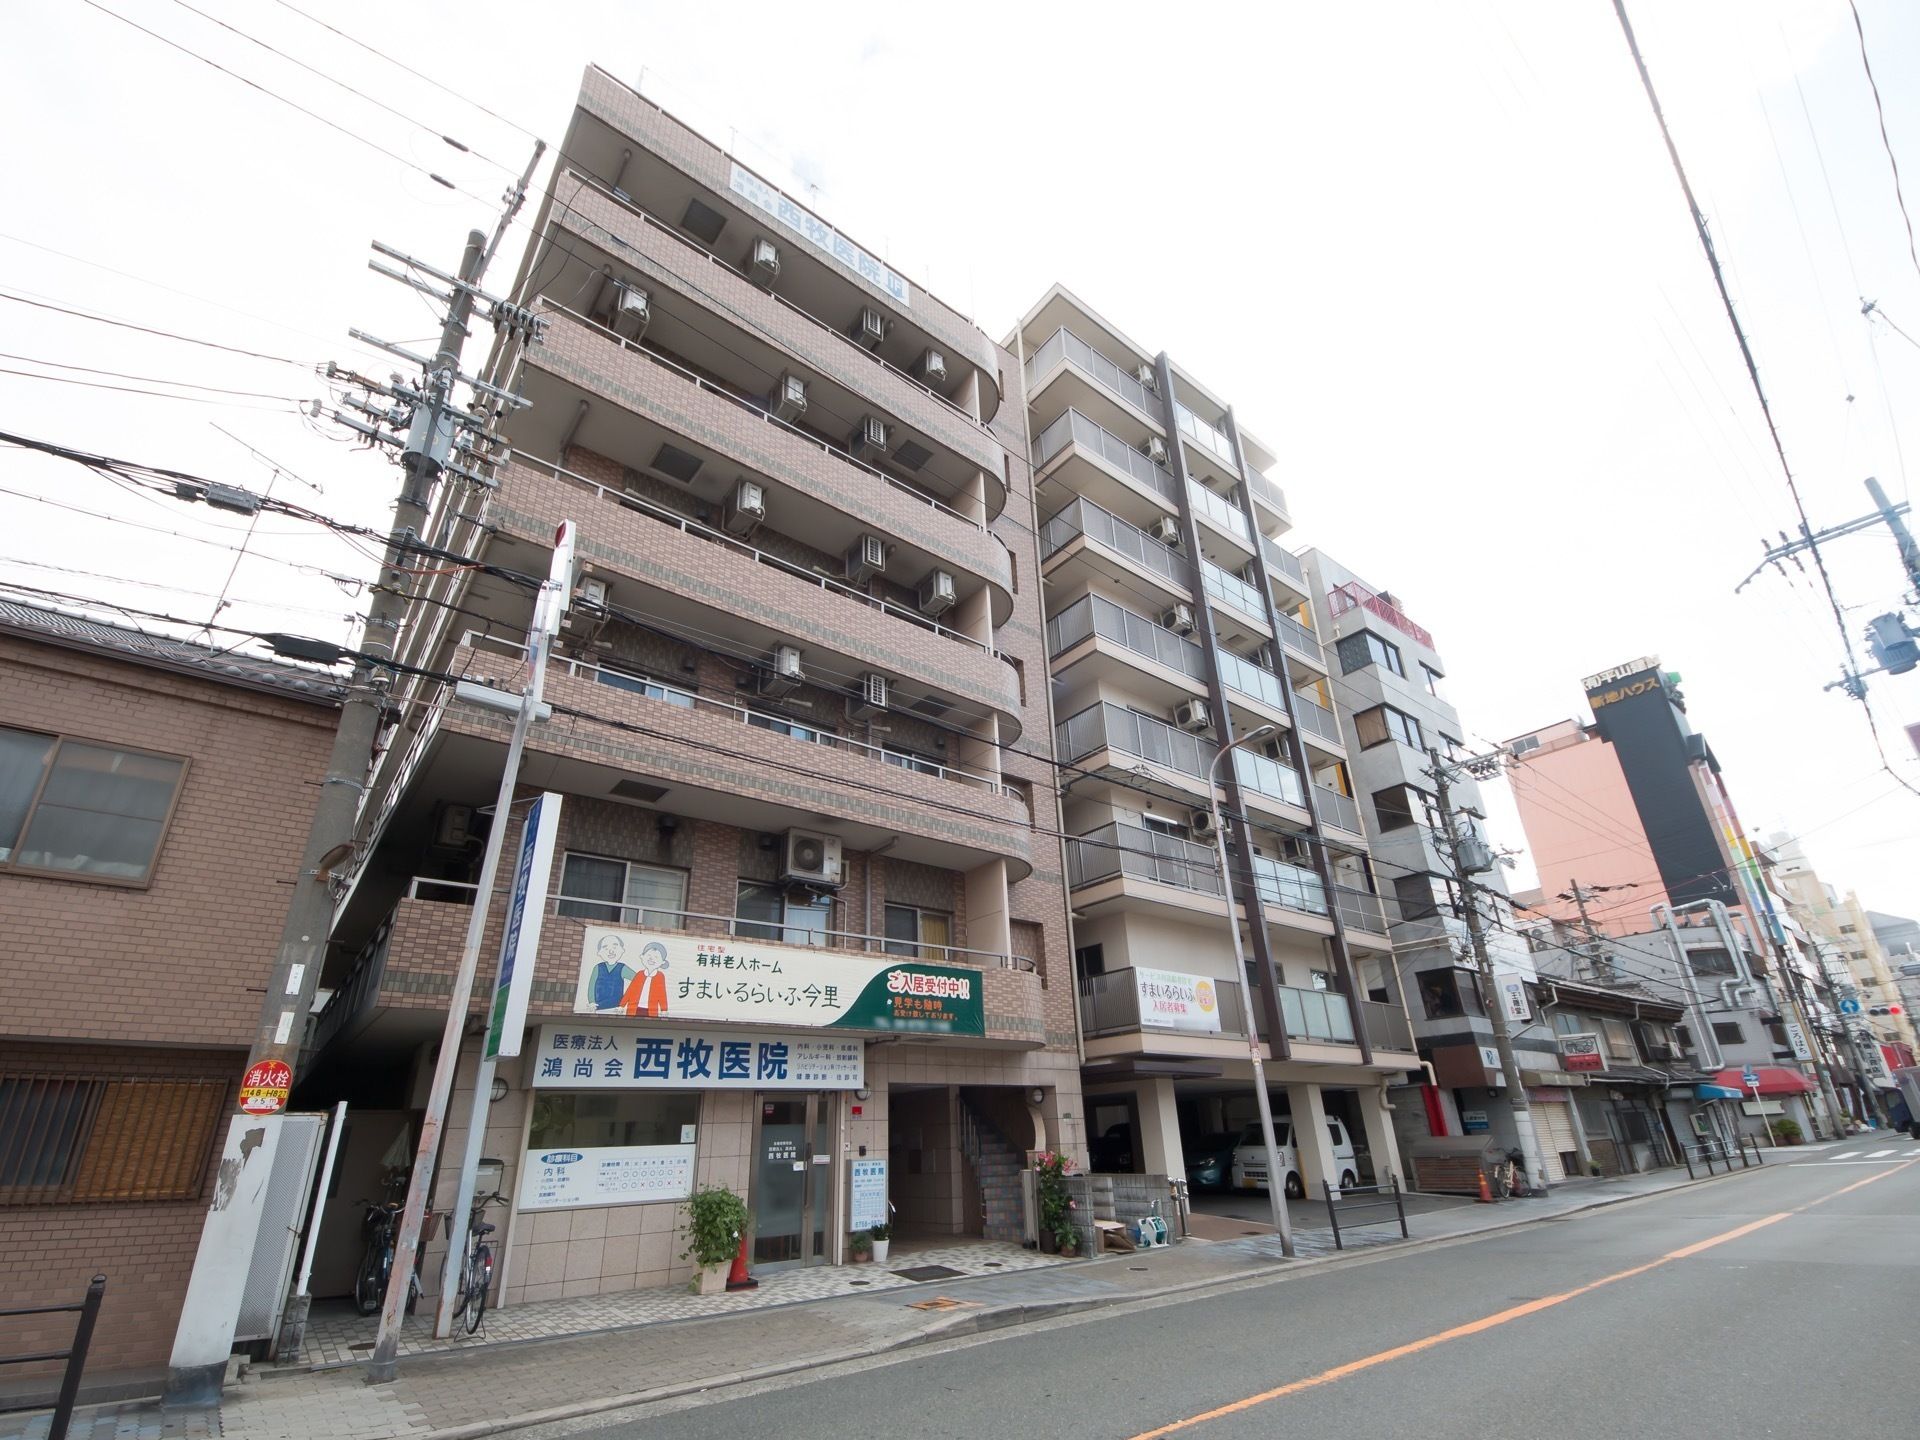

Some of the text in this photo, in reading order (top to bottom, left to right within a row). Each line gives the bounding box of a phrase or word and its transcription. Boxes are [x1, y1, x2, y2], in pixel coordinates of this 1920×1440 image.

[778, 196, 881, 284] 西牧医院
[697, 944, 725, 954] 住宅型
[696, 953, 783, 974] 有料老人ホーム
[678, 977, 841, 1009] すまいるらいふ今里
[1140, 981, 1196, 1002] すまいるらいふ
[553, 1034, 618, 1051] 医療法人
[541, 1057, 623, 1078] 鴻尚会
[634, 1037, 788, 1080] 西牧医院
[247, 1069, 289, 1087] 消火栓
[544, 1167, 565, 1176] 内科
